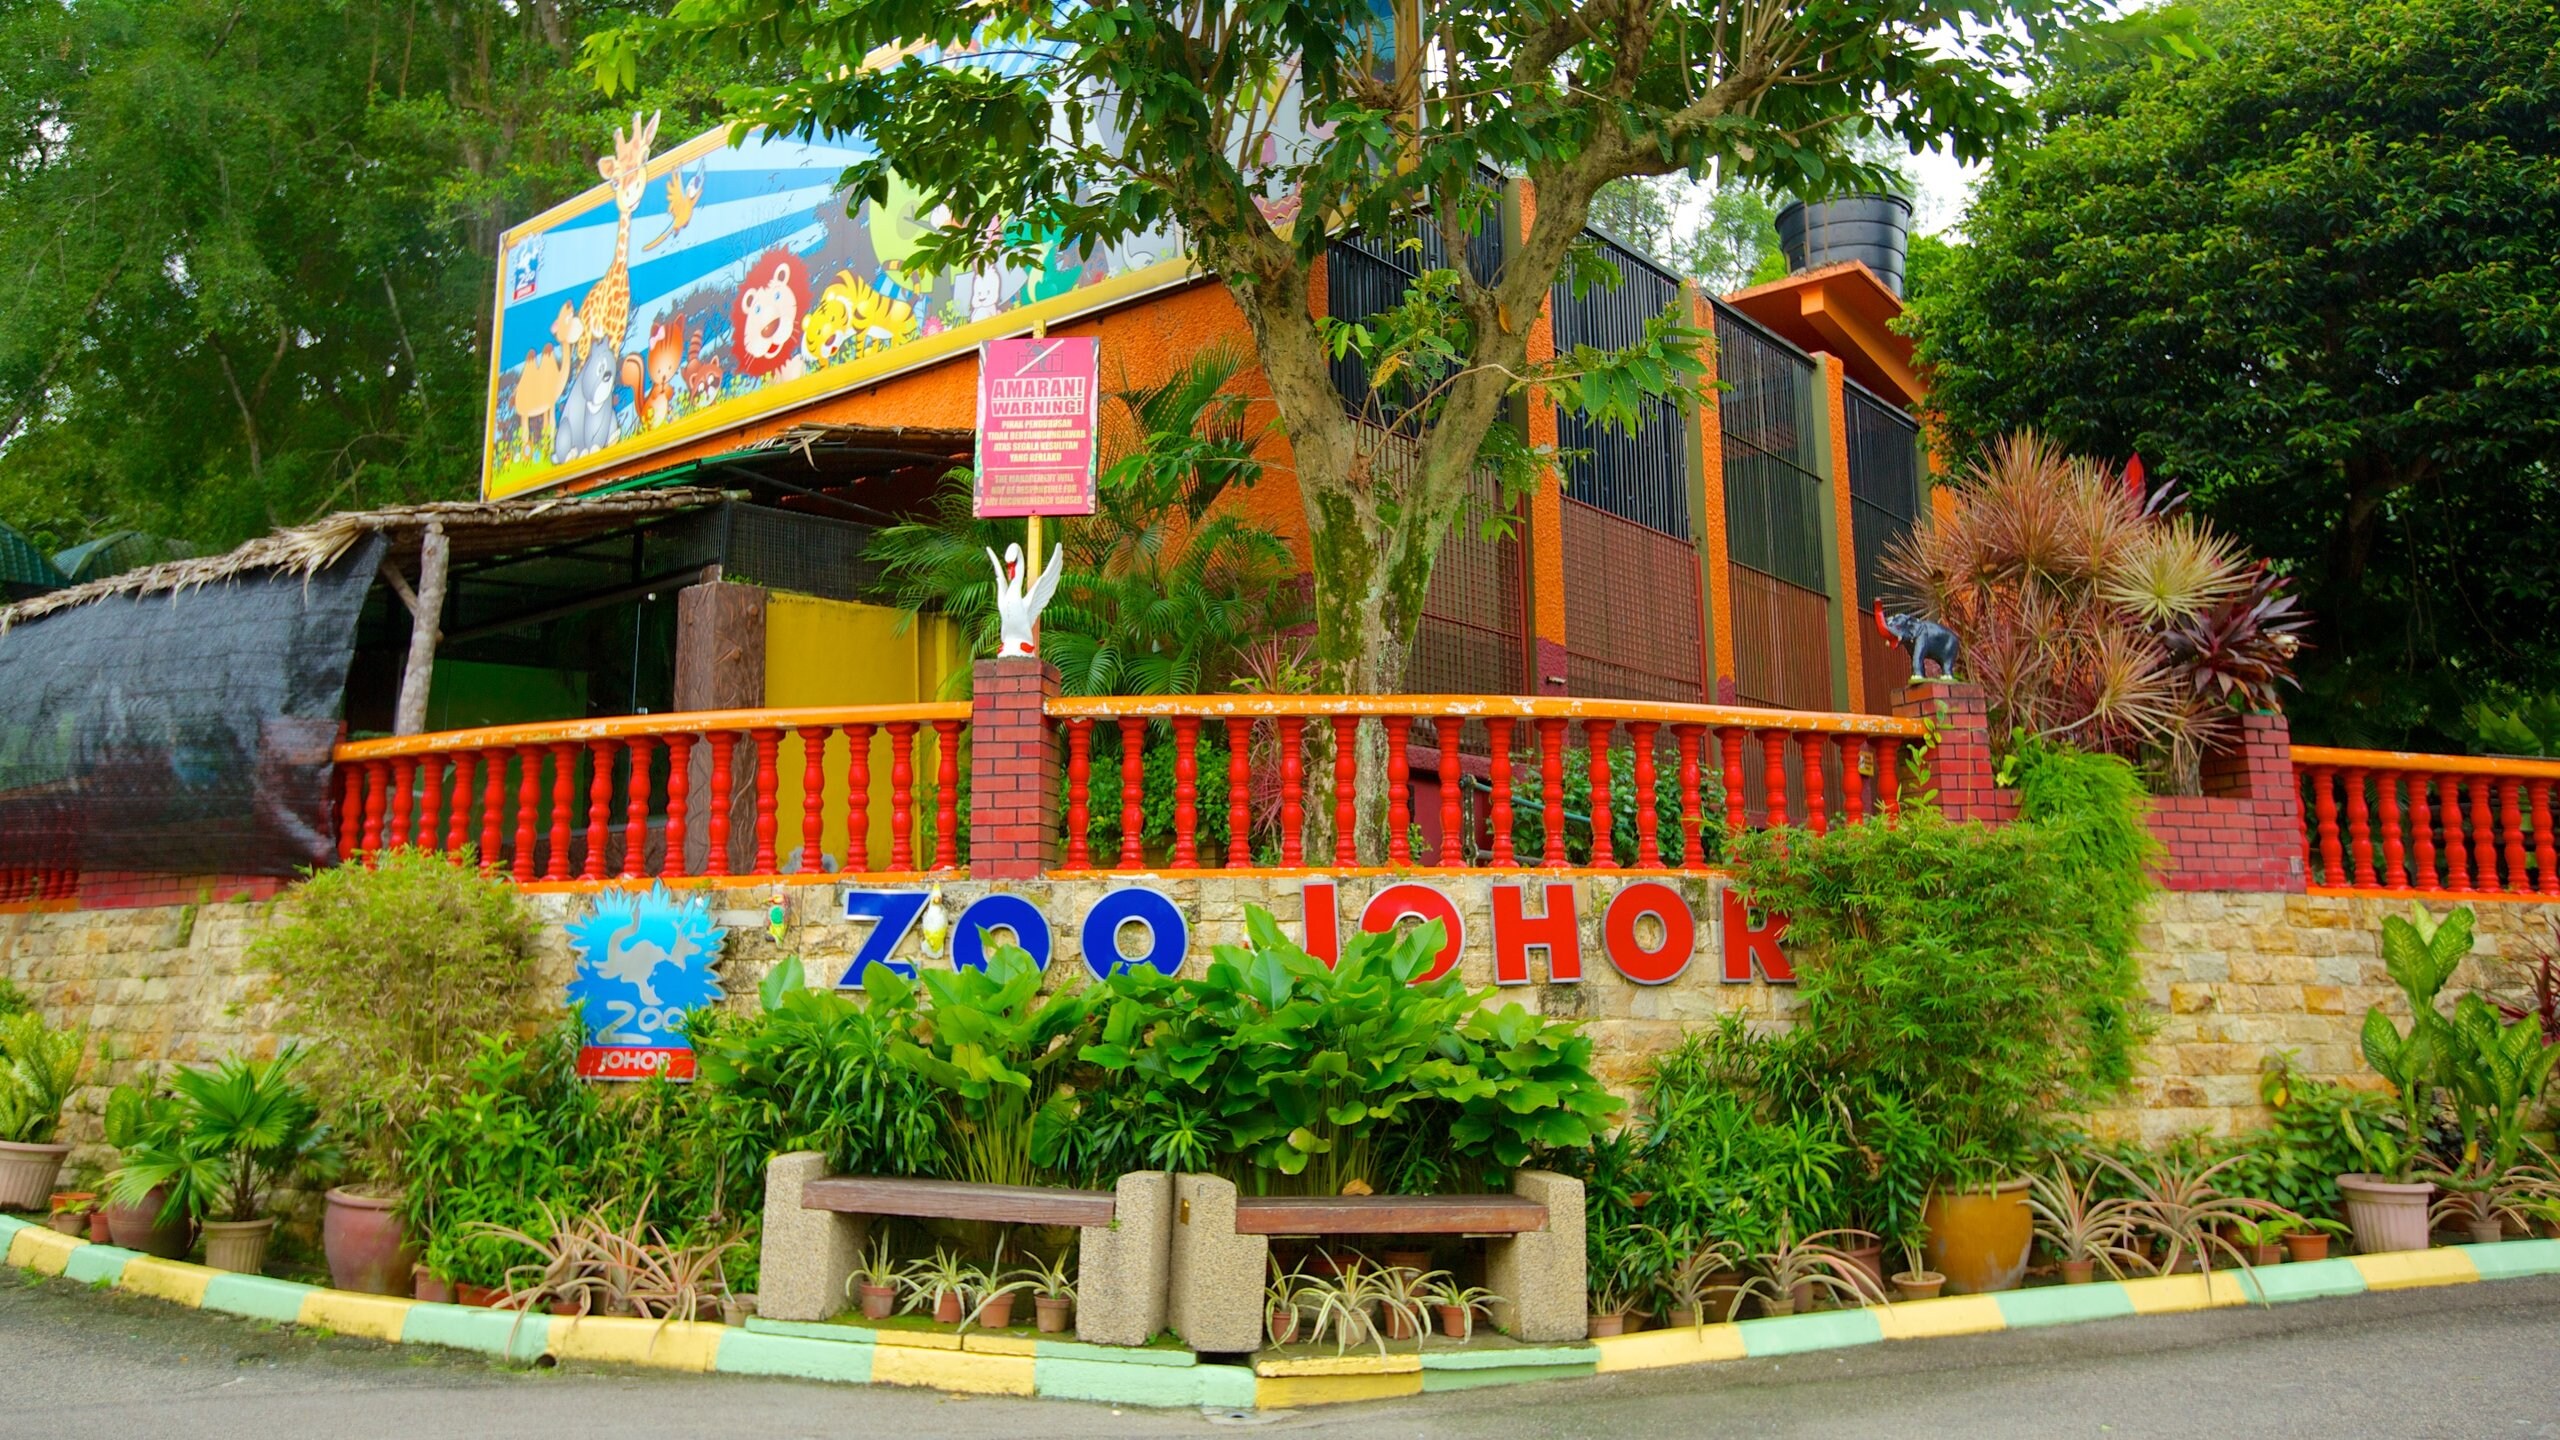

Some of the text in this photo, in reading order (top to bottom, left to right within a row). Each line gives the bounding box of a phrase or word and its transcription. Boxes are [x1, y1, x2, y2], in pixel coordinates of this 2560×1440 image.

[992, 377, 1084, 399] AMARAN!
[992, 400, 1083, 416] WARNING!
[987, 431, 1009, 440] TIDAK
[994, 441, 1078, 451] ATAS SEGALA KESULITAN
[1010, 452, 1062, 462] YANG BERLAKU
[994, 473, 1074, 484] THE MANAGEMENT WILL
[984, 497, 998, 506] ANY
[834, 881, 1798, 990] ZOO JOHOR
